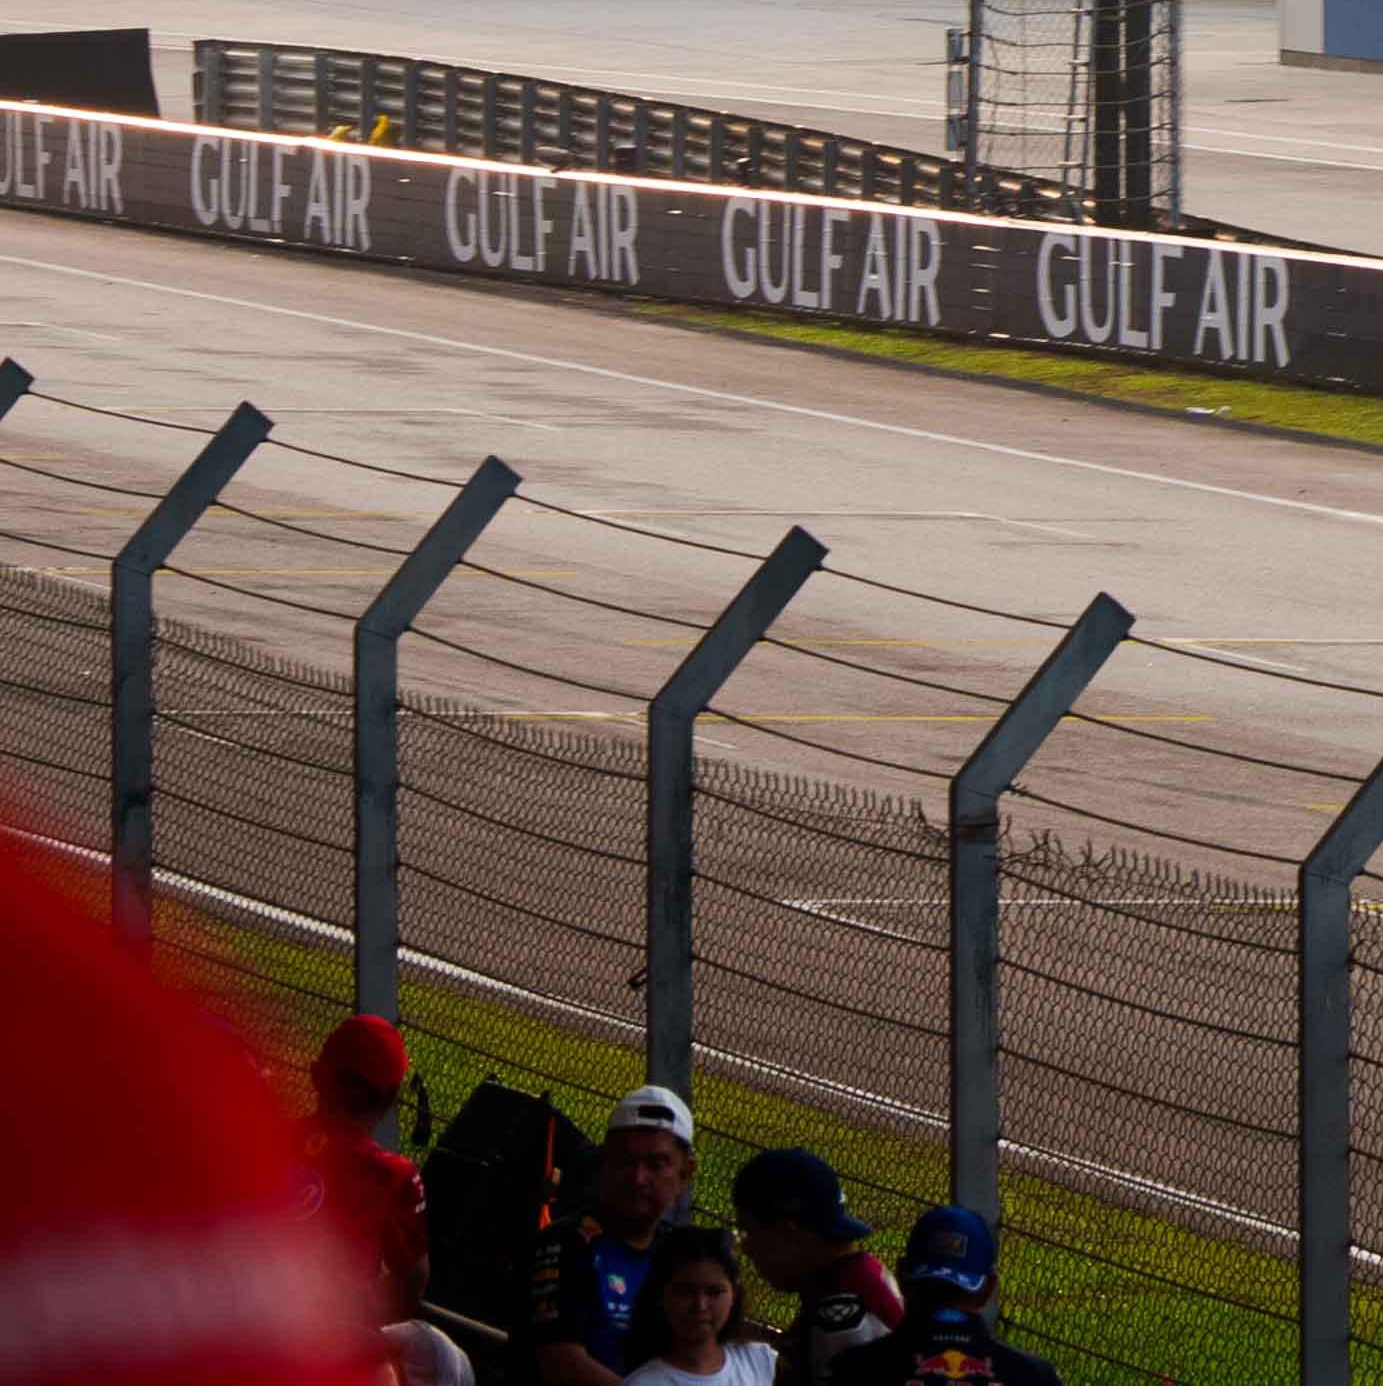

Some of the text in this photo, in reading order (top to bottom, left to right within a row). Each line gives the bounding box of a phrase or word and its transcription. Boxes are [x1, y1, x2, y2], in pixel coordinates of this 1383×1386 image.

[0, 113, 124, 215] ULF AIR
[191, 135, 371, 253] GULF AIR
[446, 169, 639, 286] GULF AIR
[721, 196, 942, 327] GULF AIR
[1037, 232, 1291, 368] GULF AIR
